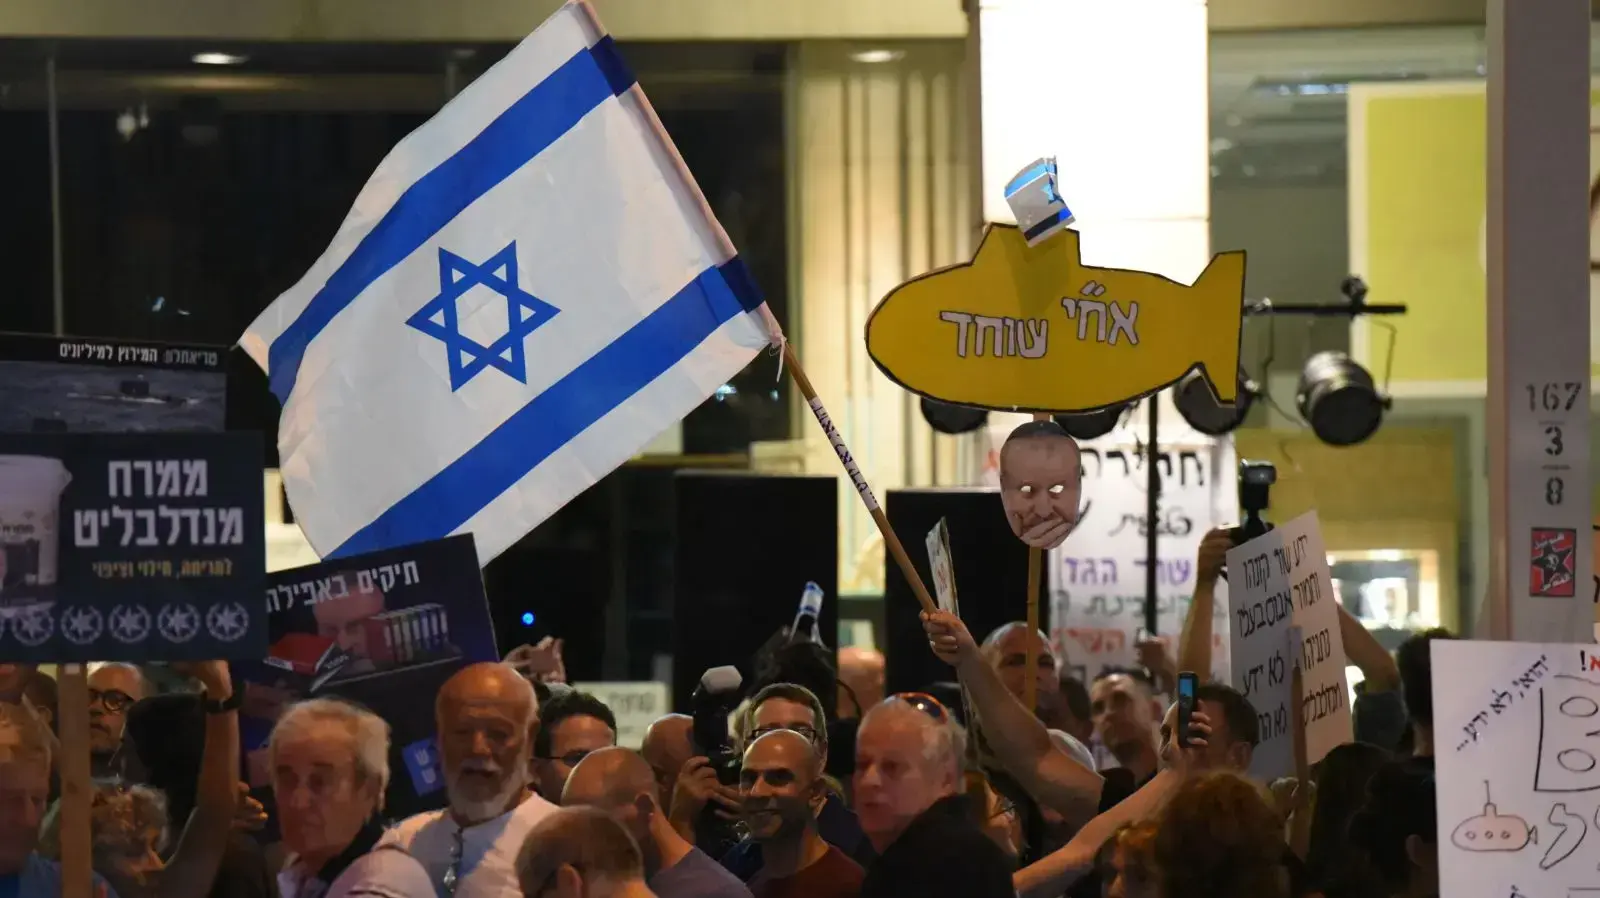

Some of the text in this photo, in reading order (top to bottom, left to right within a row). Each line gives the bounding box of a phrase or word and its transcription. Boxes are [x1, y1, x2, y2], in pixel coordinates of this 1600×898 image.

[939, 311, 1049, 359] שוחד
[59, 342, 113, 360] למיליונים
[118, 347, 158, 363] המירוץ
[1525, 381, 1582, 412] 167
[1544, 426, 1564, 456] 3
[108, 459, 207, 498] ממרח
[1545, 477, 1564, 506] 8
[74, 504, 244, 547] מנדלבליט
[1273, 547, 1292, 576] שור
[1292, 534, 1308, 568] ידע
[265, 560, 420, 613] תיקים באפילה
[1241, 628, 1331, 698] נתניהו לא ידע
[1489, 689, 1513, 715] לא
